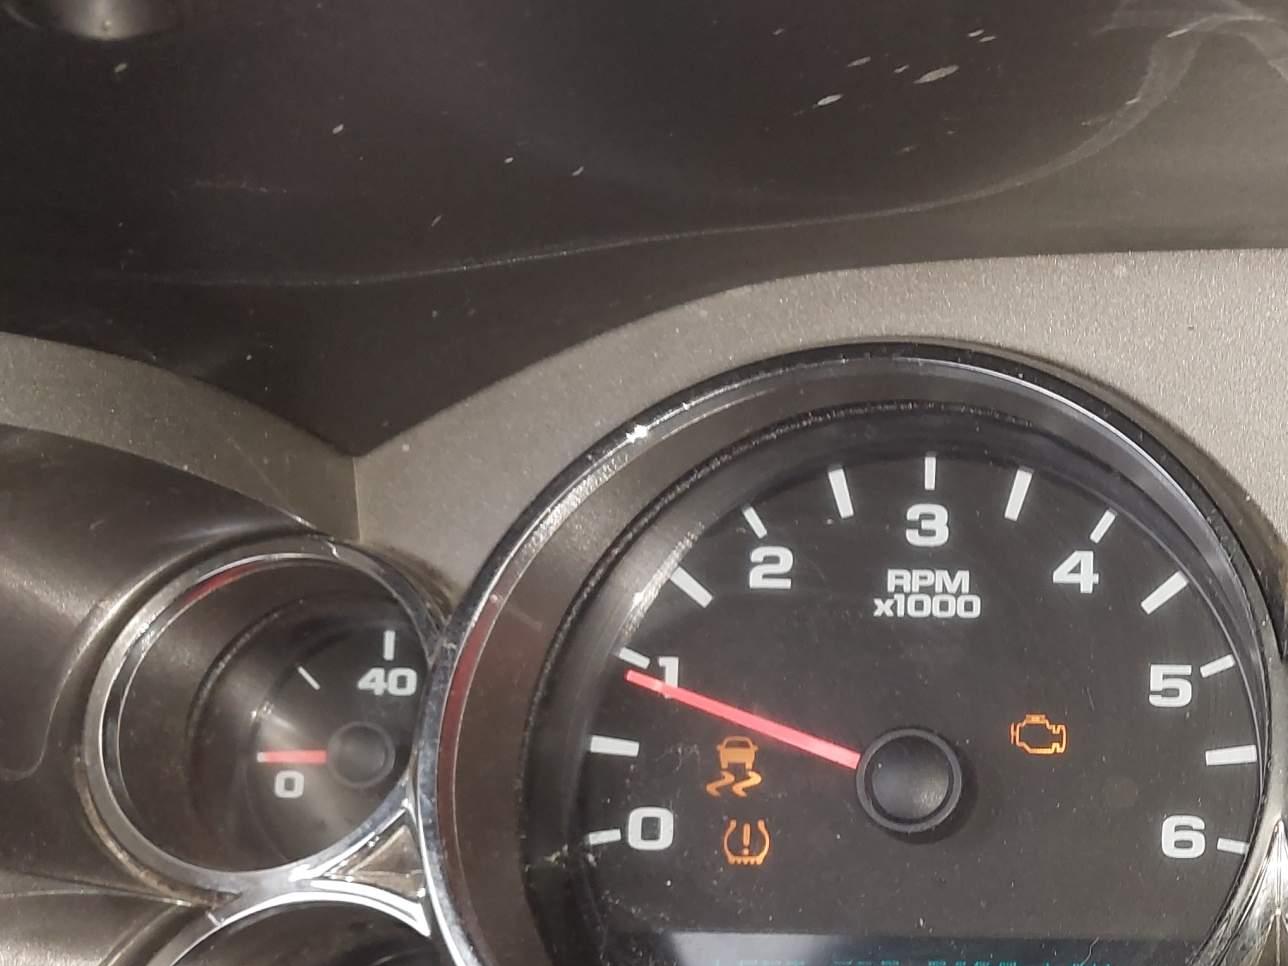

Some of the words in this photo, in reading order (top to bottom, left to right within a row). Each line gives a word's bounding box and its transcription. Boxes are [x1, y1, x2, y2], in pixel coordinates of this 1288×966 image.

[904, 504, 949, 547] 3
[748, 546, 794, 589] 2
[886, 569, 970, 594] RPM
[1052, 551, 1099, 594] 4
[872, 594, 981, 618] x1000
[357, 667, 418, 696] 40
[656, 656, 680, 698] 1
[1148, 664, 1195, 707] 5
[274, 770, 304, 799] 0
[628, 807, 674, 850] 0
[1160, 815, 1205, 858] 6
